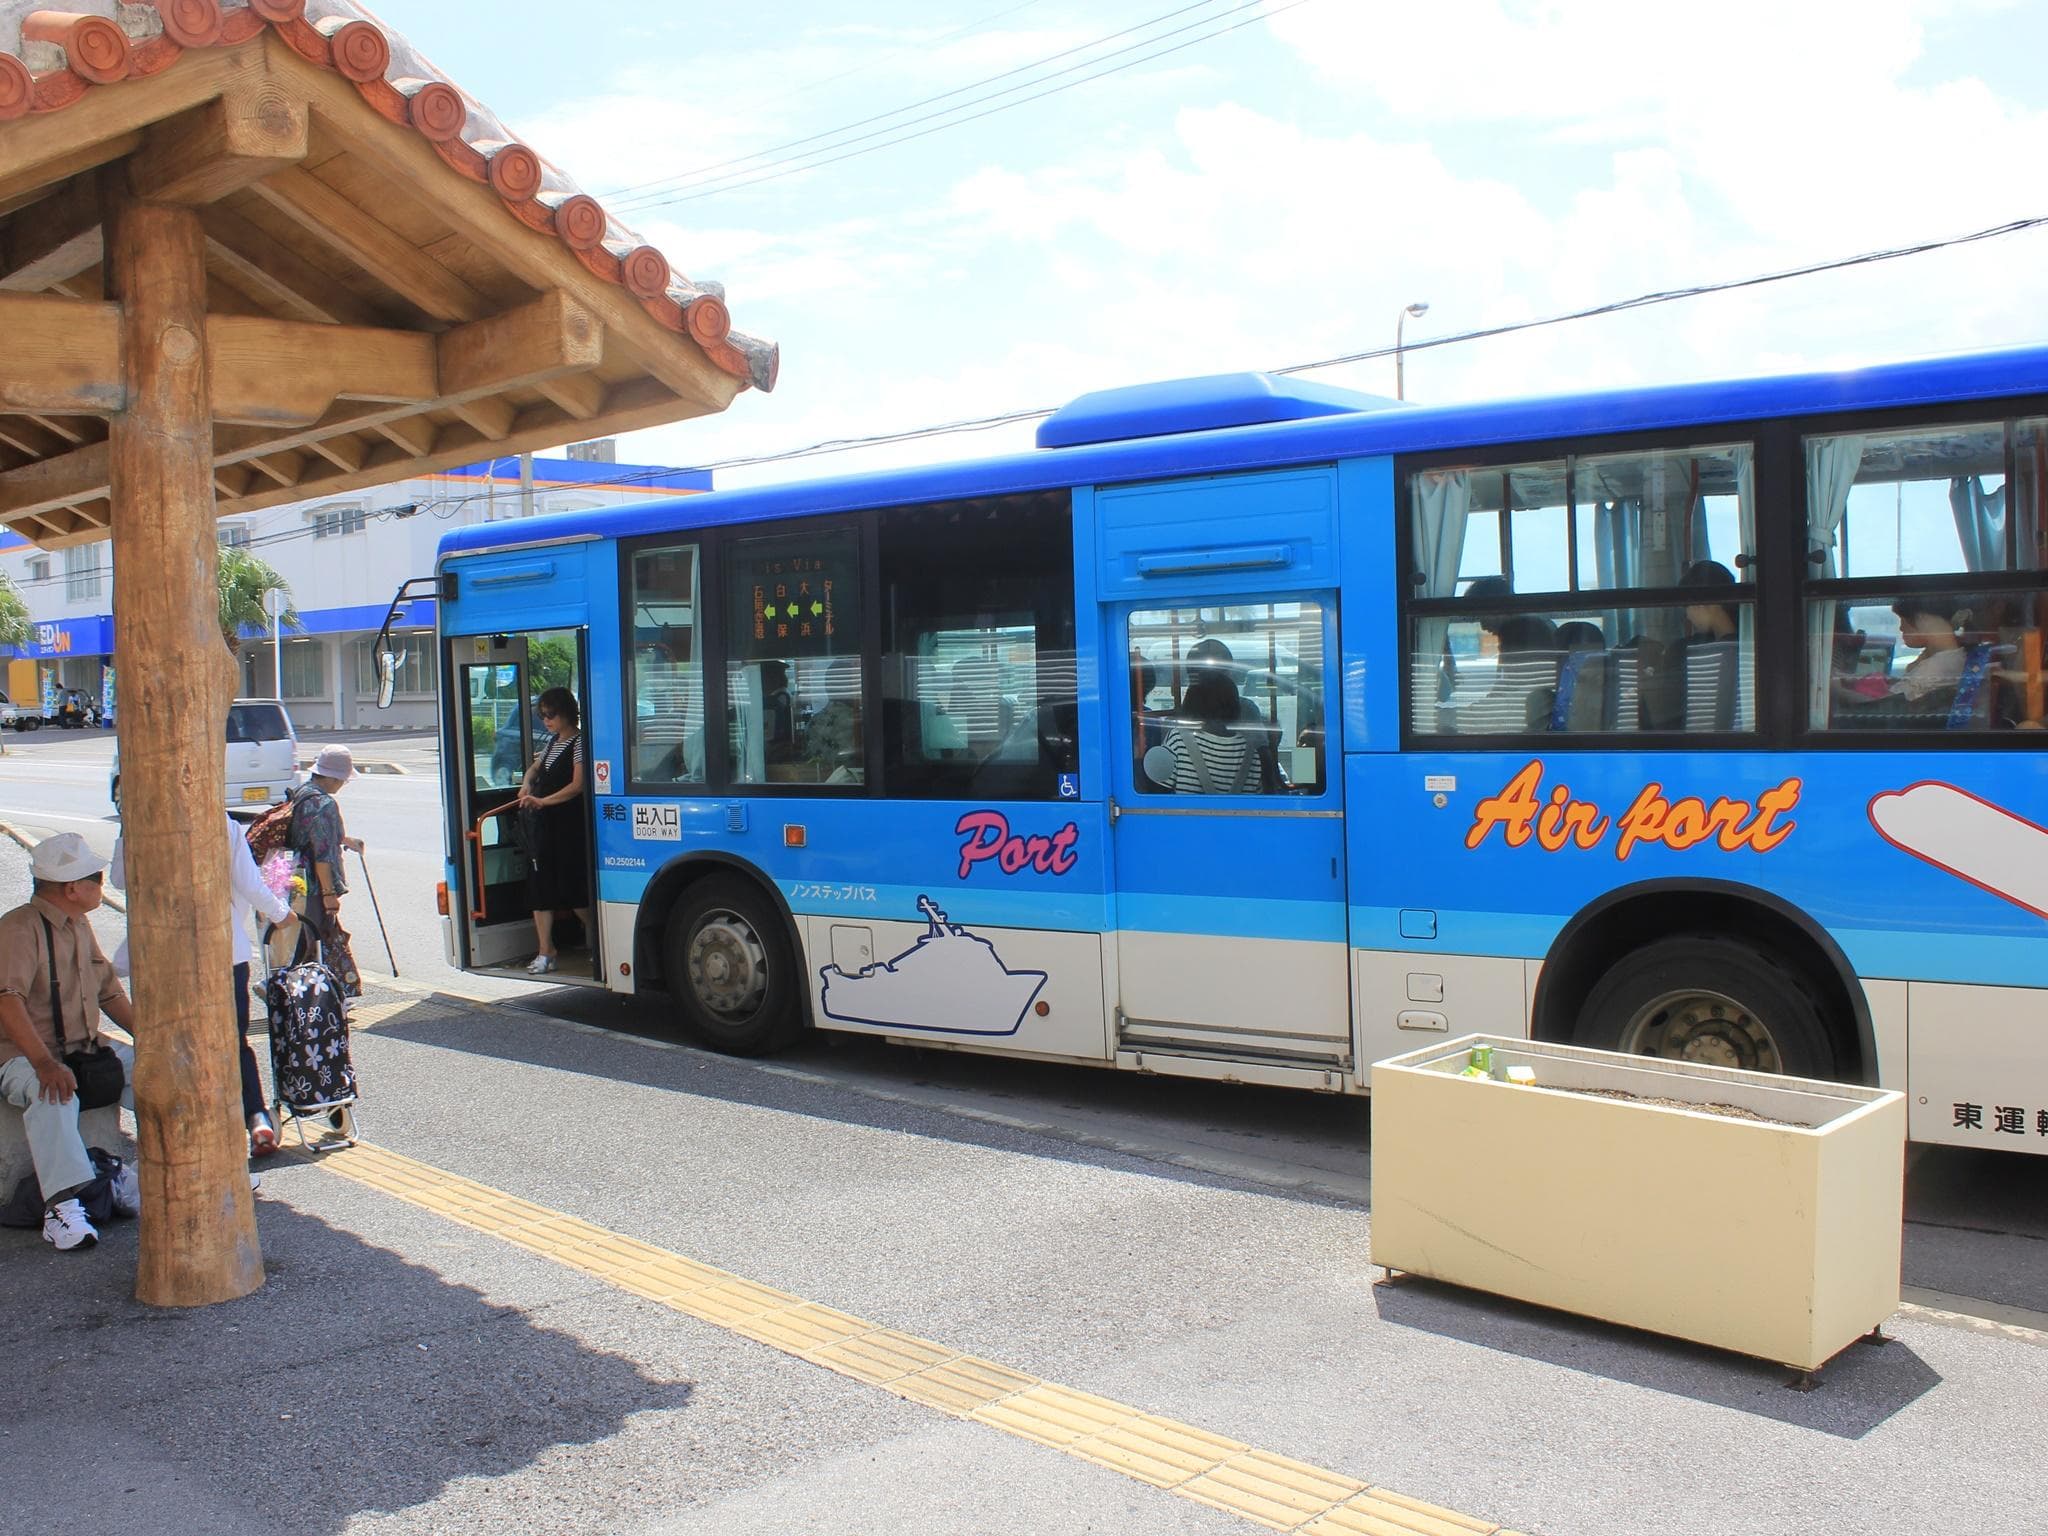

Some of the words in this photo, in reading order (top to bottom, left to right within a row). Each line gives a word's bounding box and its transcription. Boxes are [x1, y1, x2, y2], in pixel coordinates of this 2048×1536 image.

[602, 803, 627, 821] 乗合
[636, 807, 678, 826] 出入口
[1463, 758, 1610, 852] Air
[1614, 776, 1802, 862] port
[636, 826, 657, 837] DOOR
[661, 828, 679, 839] WAY
[955, 809, 1079, 880] Port
[604, 857, 646, 867] NO.2502144
[790, 884, 876, 901] ノンステップバス
